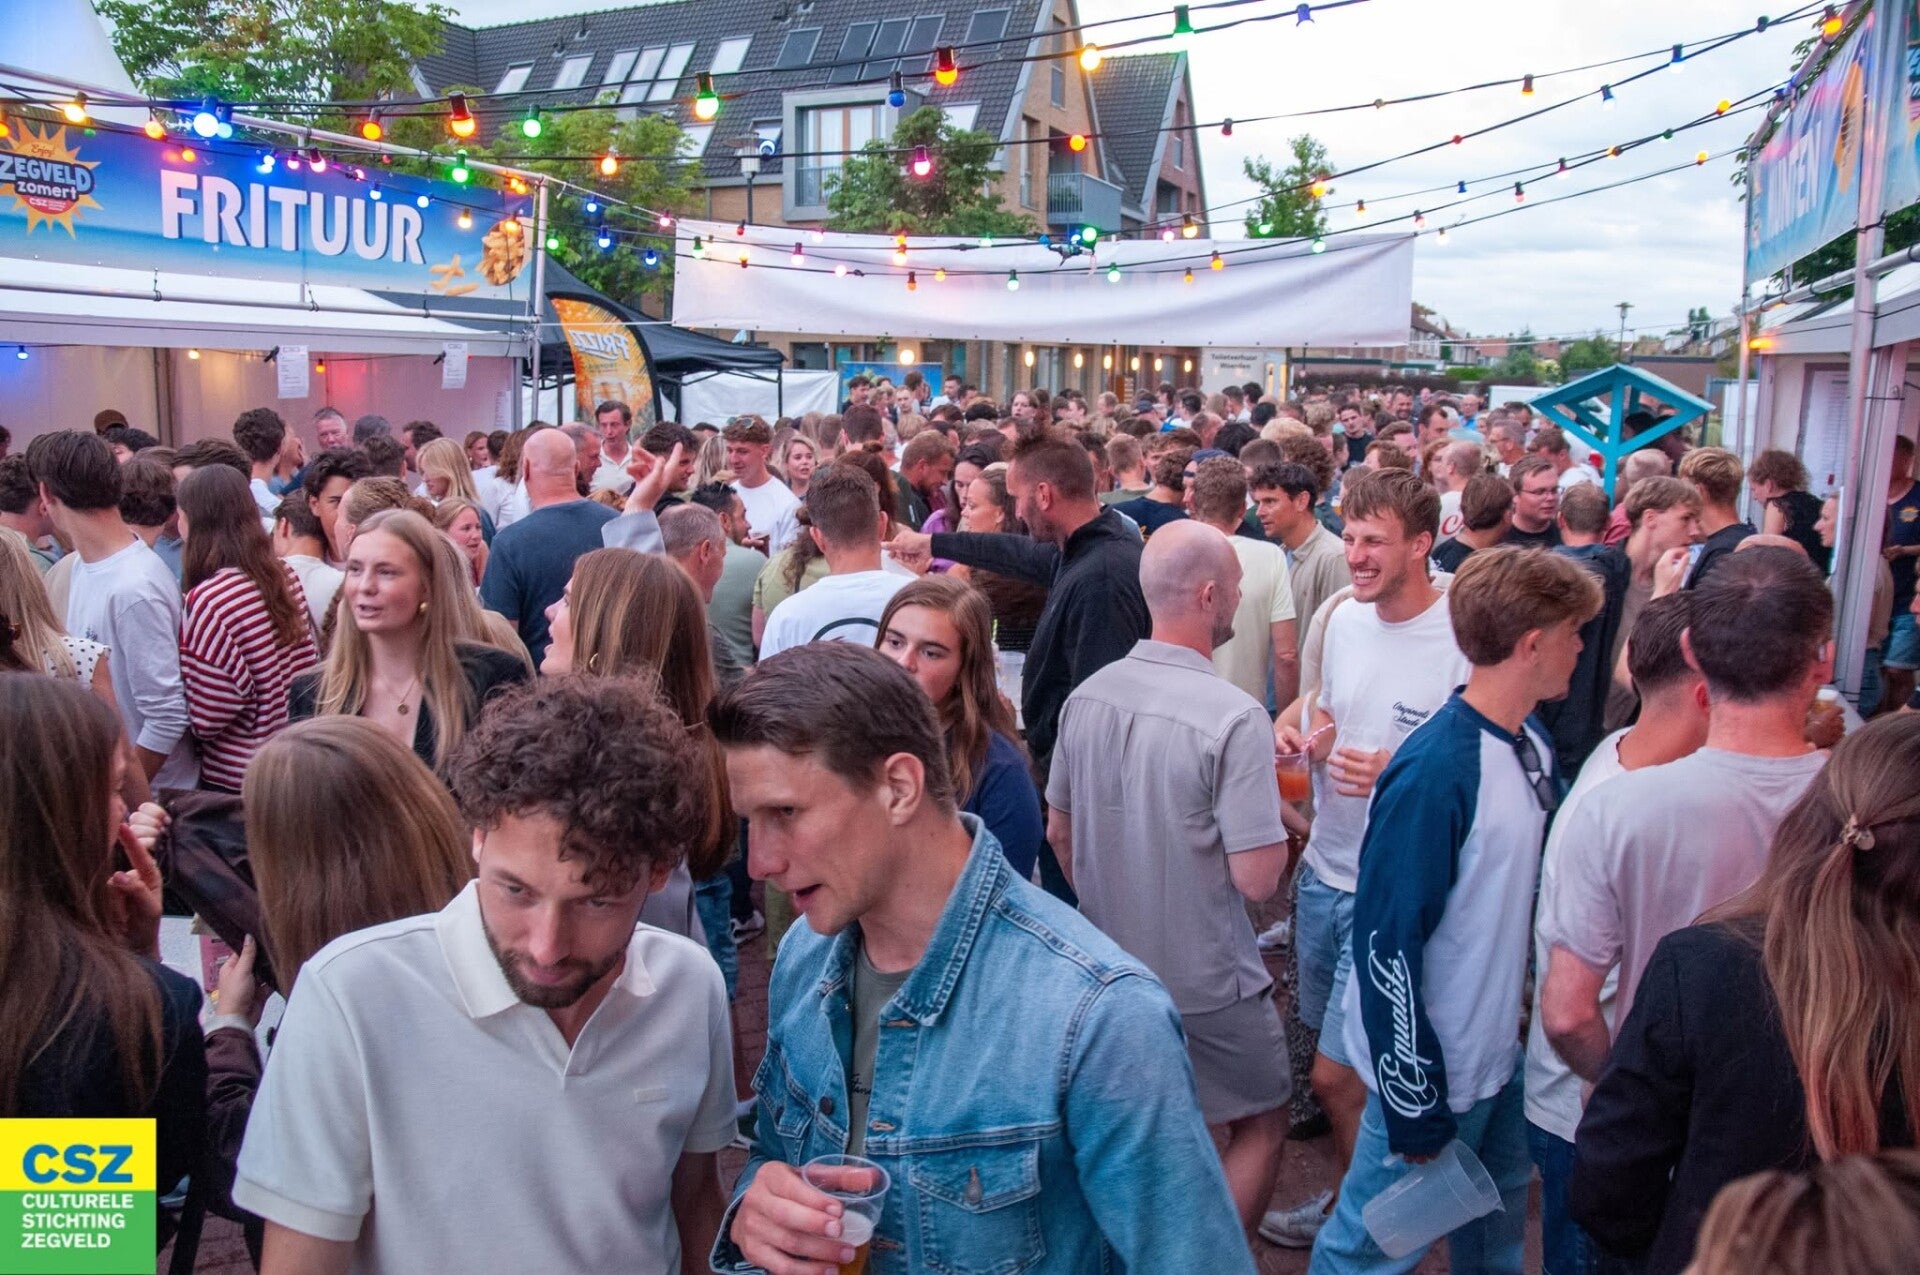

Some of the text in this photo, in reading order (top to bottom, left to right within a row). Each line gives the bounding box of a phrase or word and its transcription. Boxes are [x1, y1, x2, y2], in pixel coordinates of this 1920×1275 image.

[0, 153, 92, 192] ZEGVELD
[17, 180, 77, 200] zomert
[161, 169, 426, 264] FRITUUR
